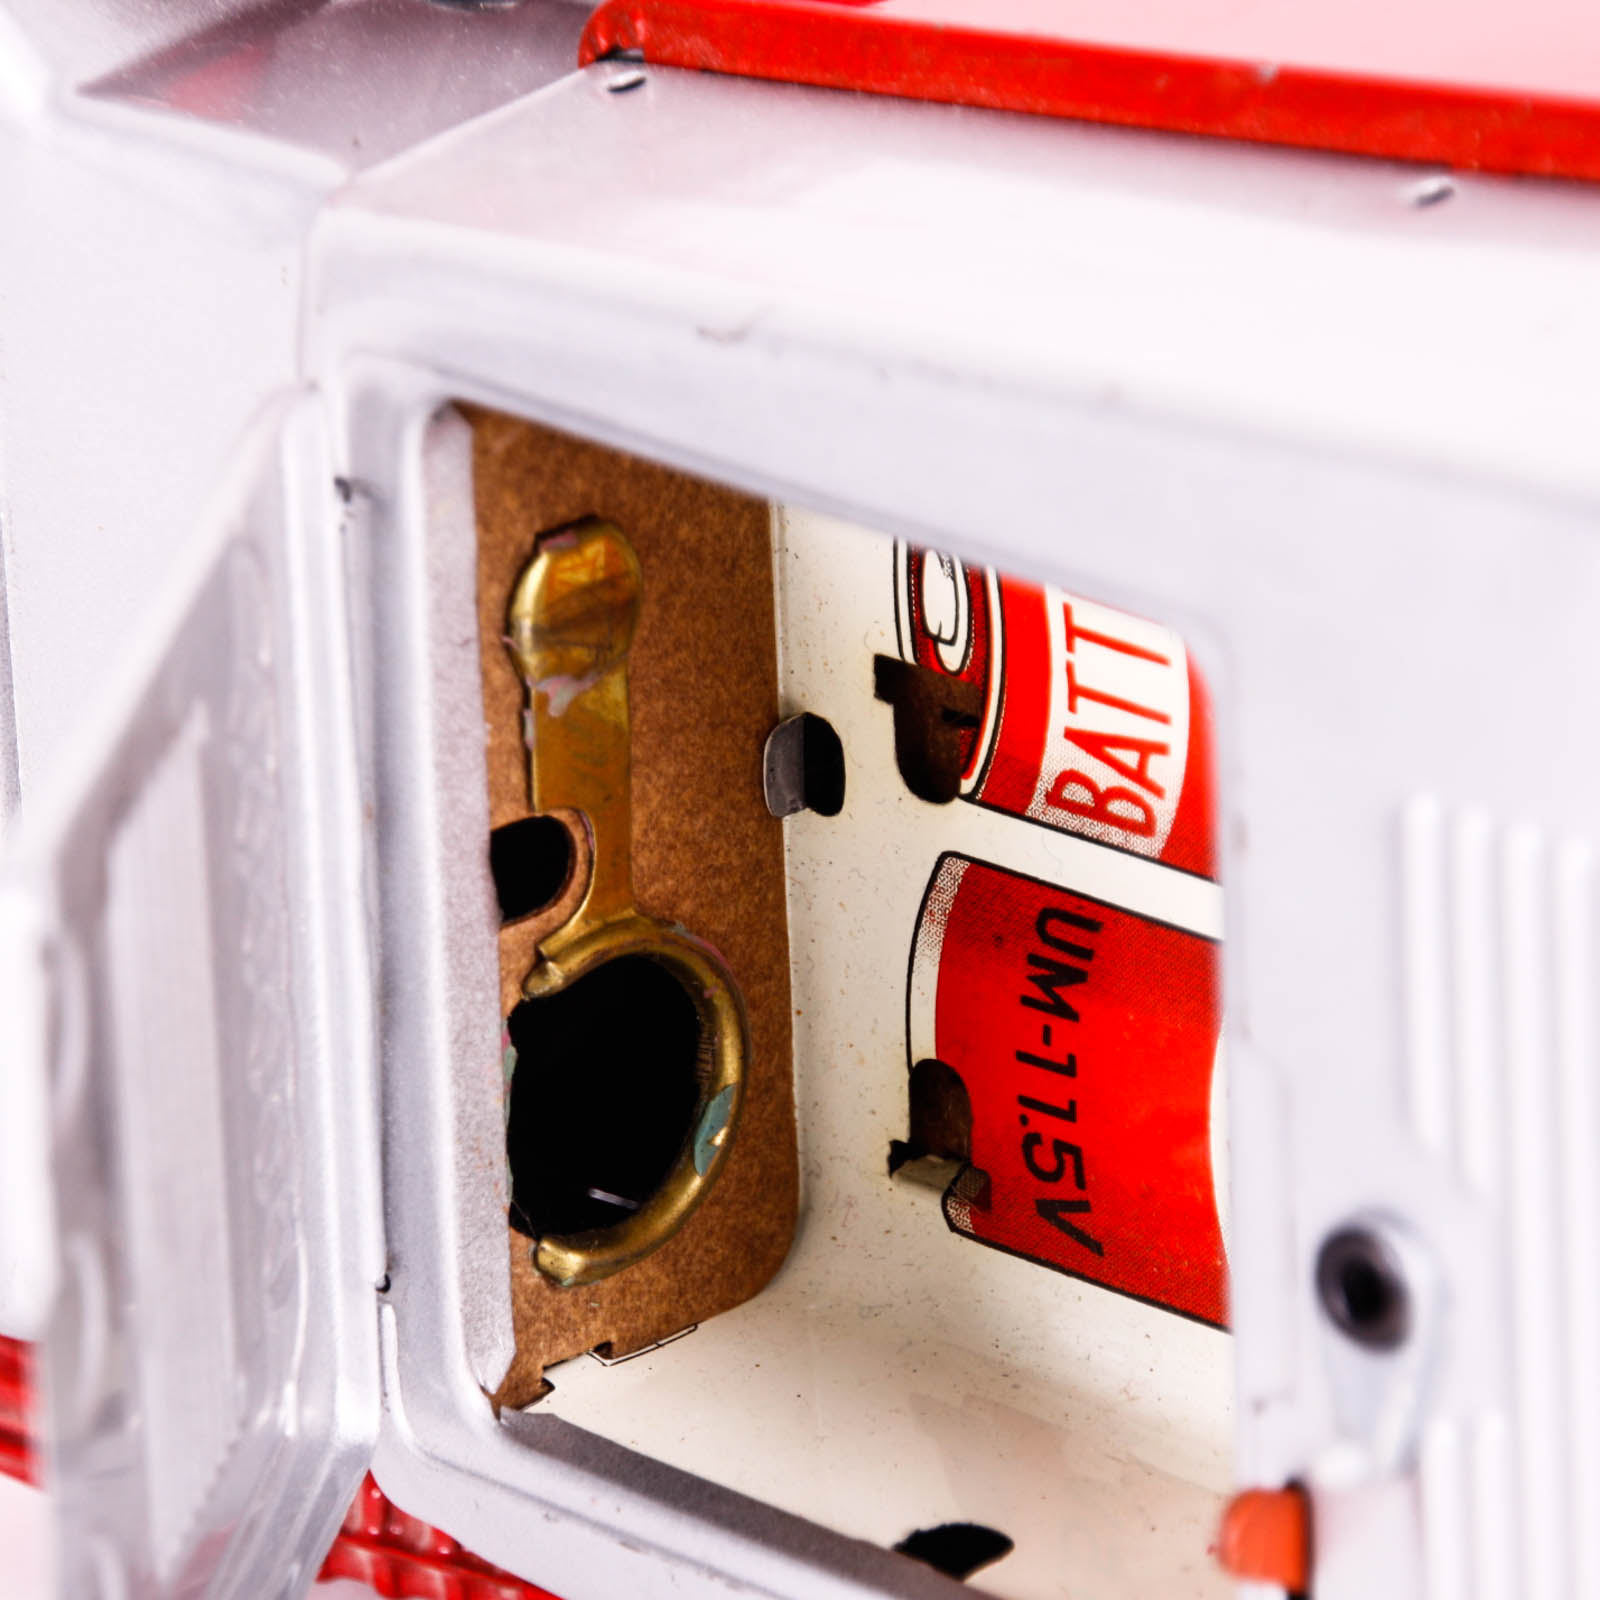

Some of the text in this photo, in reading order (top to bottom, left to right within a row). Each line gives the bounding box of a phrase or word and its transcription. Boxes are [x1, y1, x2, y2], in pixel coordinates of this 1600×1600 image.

[1045, 600, 1173, 838] BATT
[1015, 907, 1105, 1257] UM-1 1.5V
